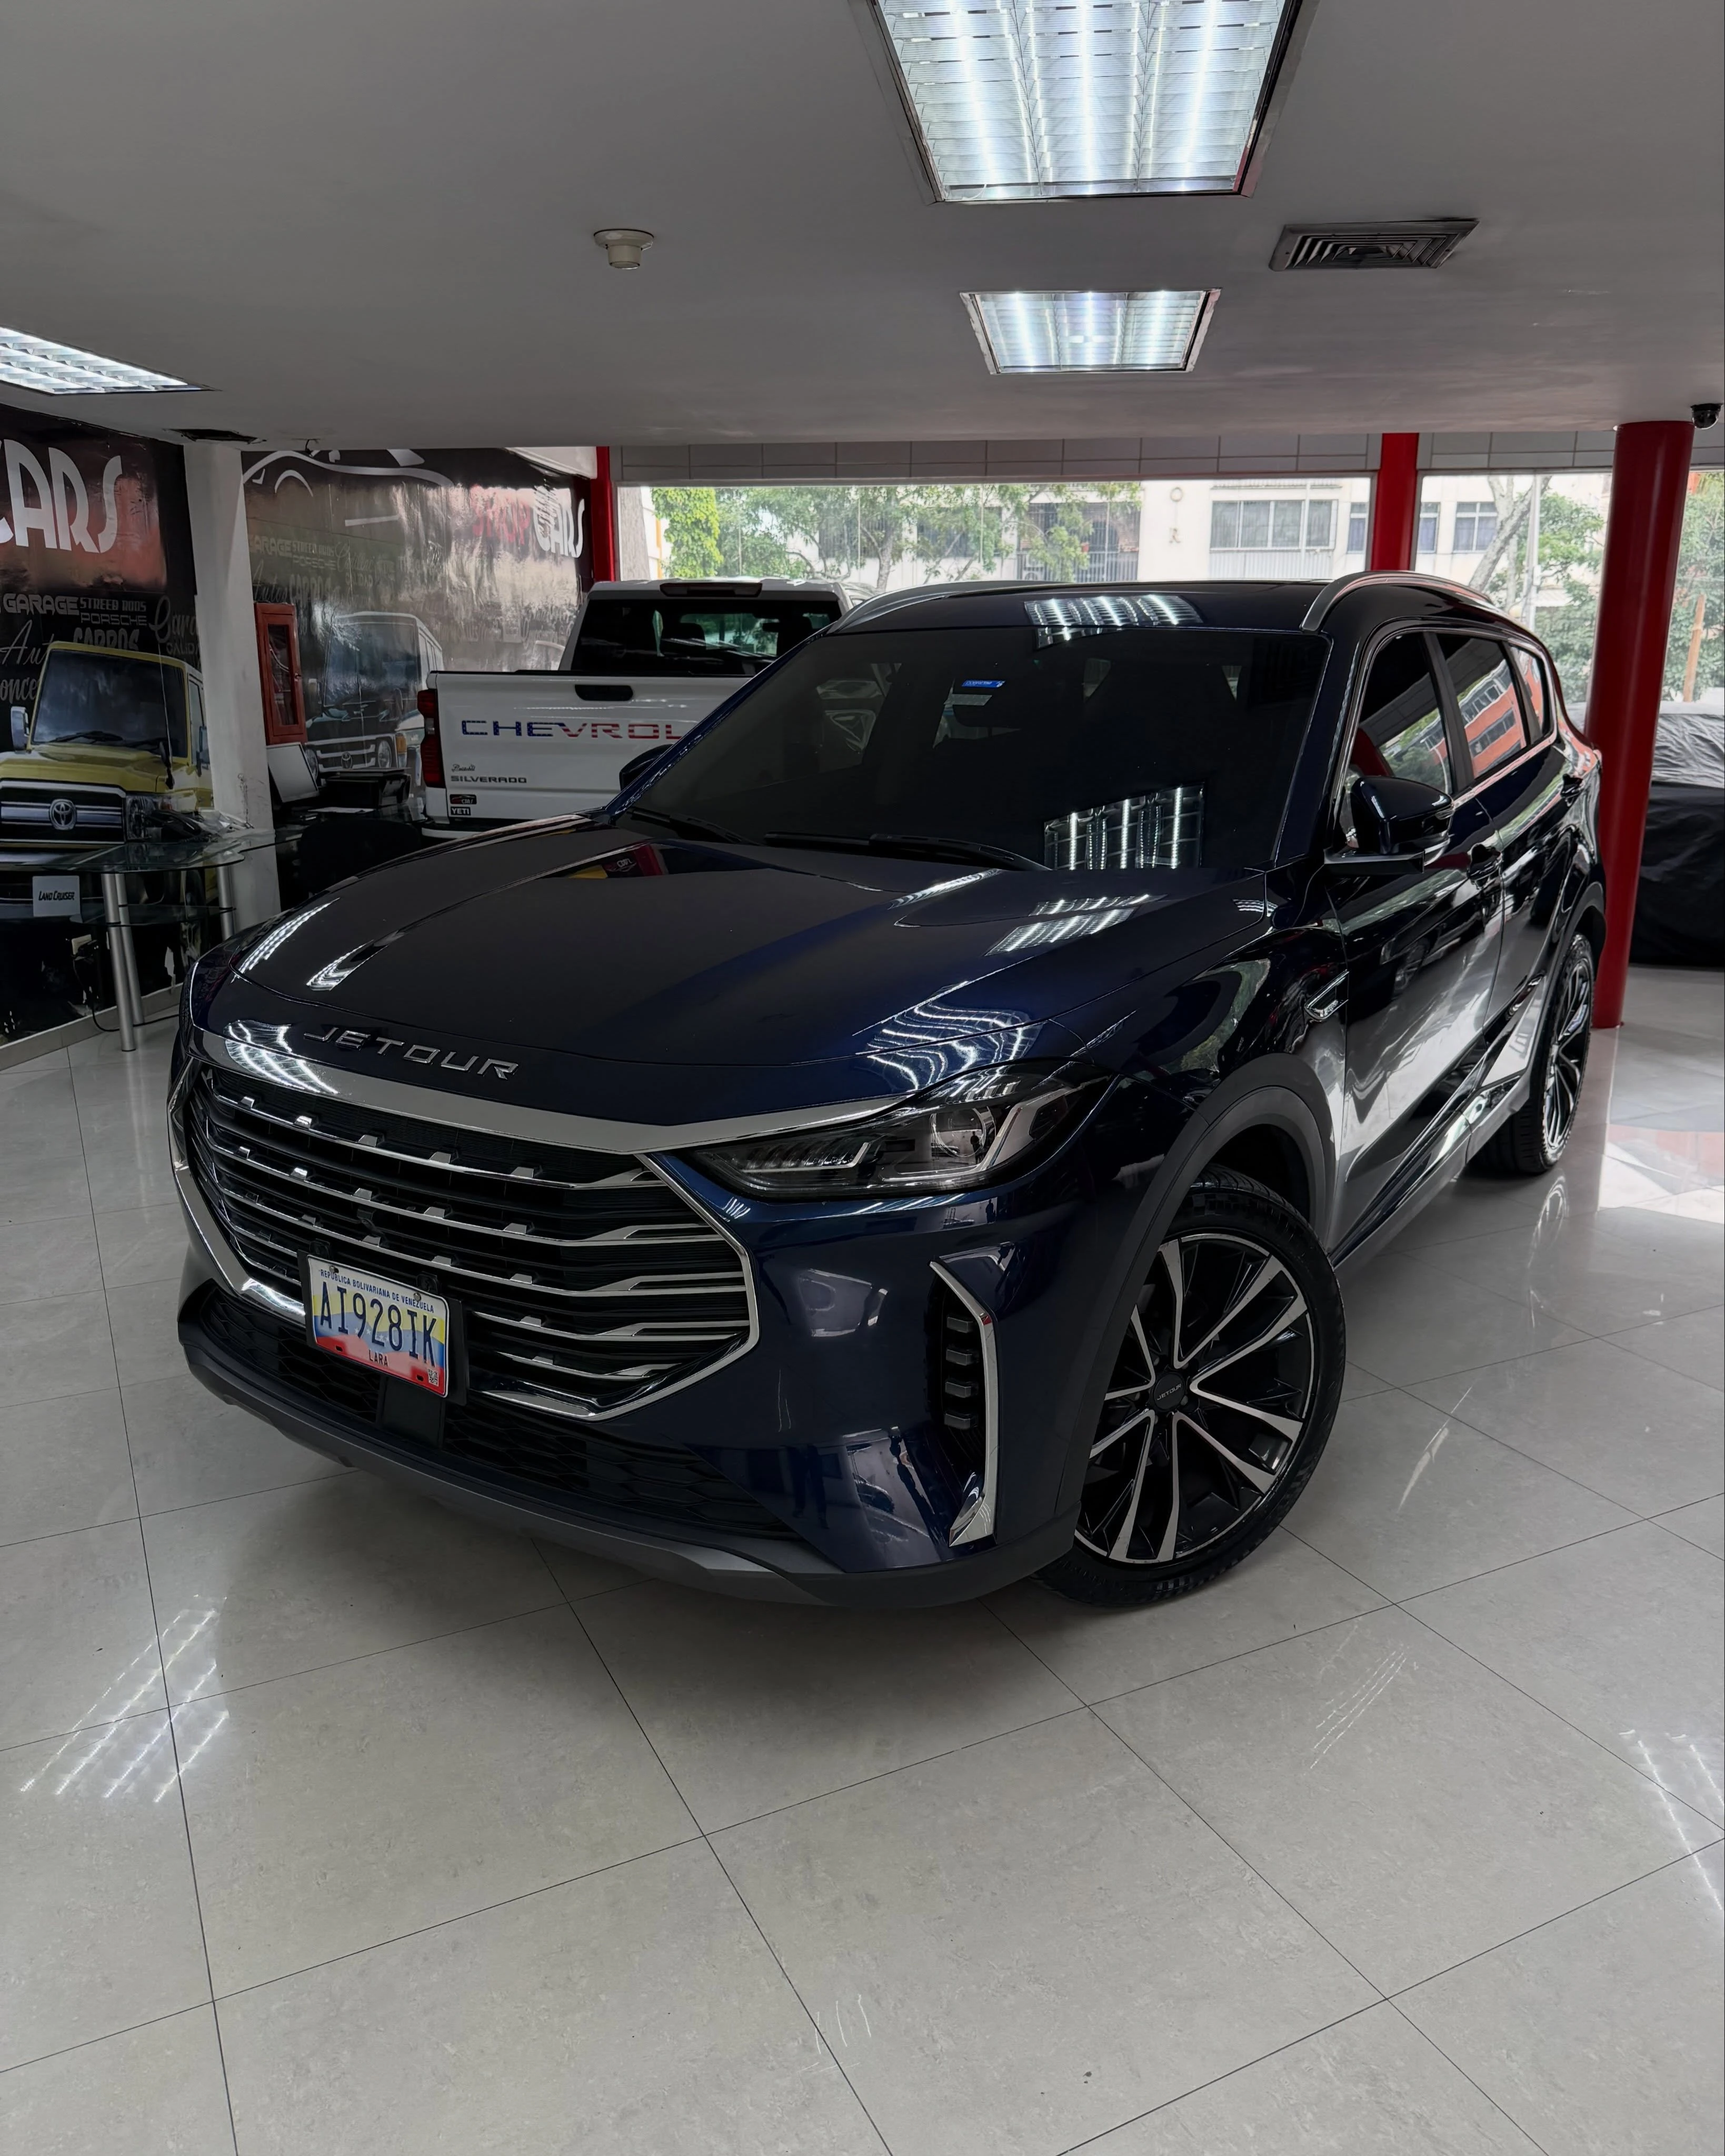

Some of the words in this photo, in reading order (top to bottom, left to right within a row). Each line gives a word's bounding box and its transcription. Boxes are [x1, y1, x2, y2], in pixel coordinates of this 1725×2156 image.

[3, 593, 80, 616] GARAGE
[81, 612, 147, 626] PORSCHE
[461, 720, 683, 740] CHEVROL
[451, 775, 527, 784] SILVERADO
[38, 891, 53, 901] LAND
[53, 891, 75, 901] CRUISER
[303, 1027, 519, 1081] JETOUR
[352, 1280, 391, 1299] BOLIVARIANA
[392, 1292, 400, 1302] DE
[401, 1296, 434, 1313] VENEZUELA
[320, 1281, 437, 1368] AI928IK
[368, 1349, 388, 1367] LARA
[1156, 1383, 1182, 1401] JETOUR
